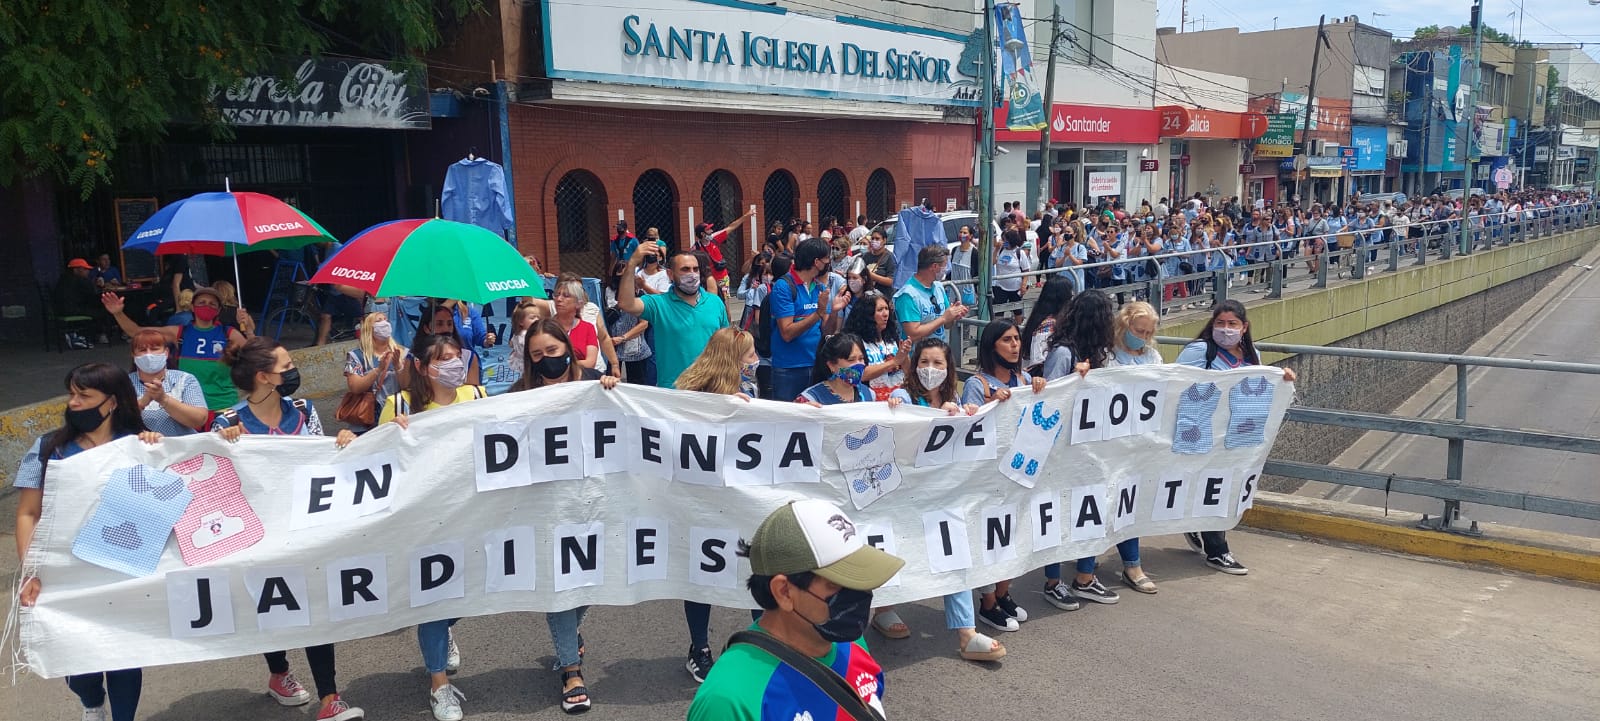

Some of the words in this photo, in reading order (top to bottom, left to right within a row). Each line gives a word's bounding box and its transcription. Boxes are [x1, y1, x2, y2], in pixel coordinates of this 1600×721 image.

[621, 14, 735, 66] SANTA
[741, 30, 837, 75] IGLESIA
[841, 41, 885, 79] DEL
[886, 48, 952, 85] SEÑOR
[337, 61, 409, 118] City
[219, 107, 292, 124] ESTO
[1066, 115, 1111, 133] Santander
[1162, 116, 1181, 130] 24
[1260, 136, 1292, 145] Mónaco
[254, 221, 303, 234] UDOCBA
[330, 266, 377, 282] UDOCBA
[485, 278, 529, 292] UDOCBA
[196, 338, 206, 355] 2
[308, 462, 393, 514] EN
[483, 419, 814, 474] DEFENSA
[923, 420, 986, 453] DE
[1079, 389, 1159, 431] LOS
[939, 473, 1258, 557] INFANTES
[190, 527, 727, 629] JARDINES
